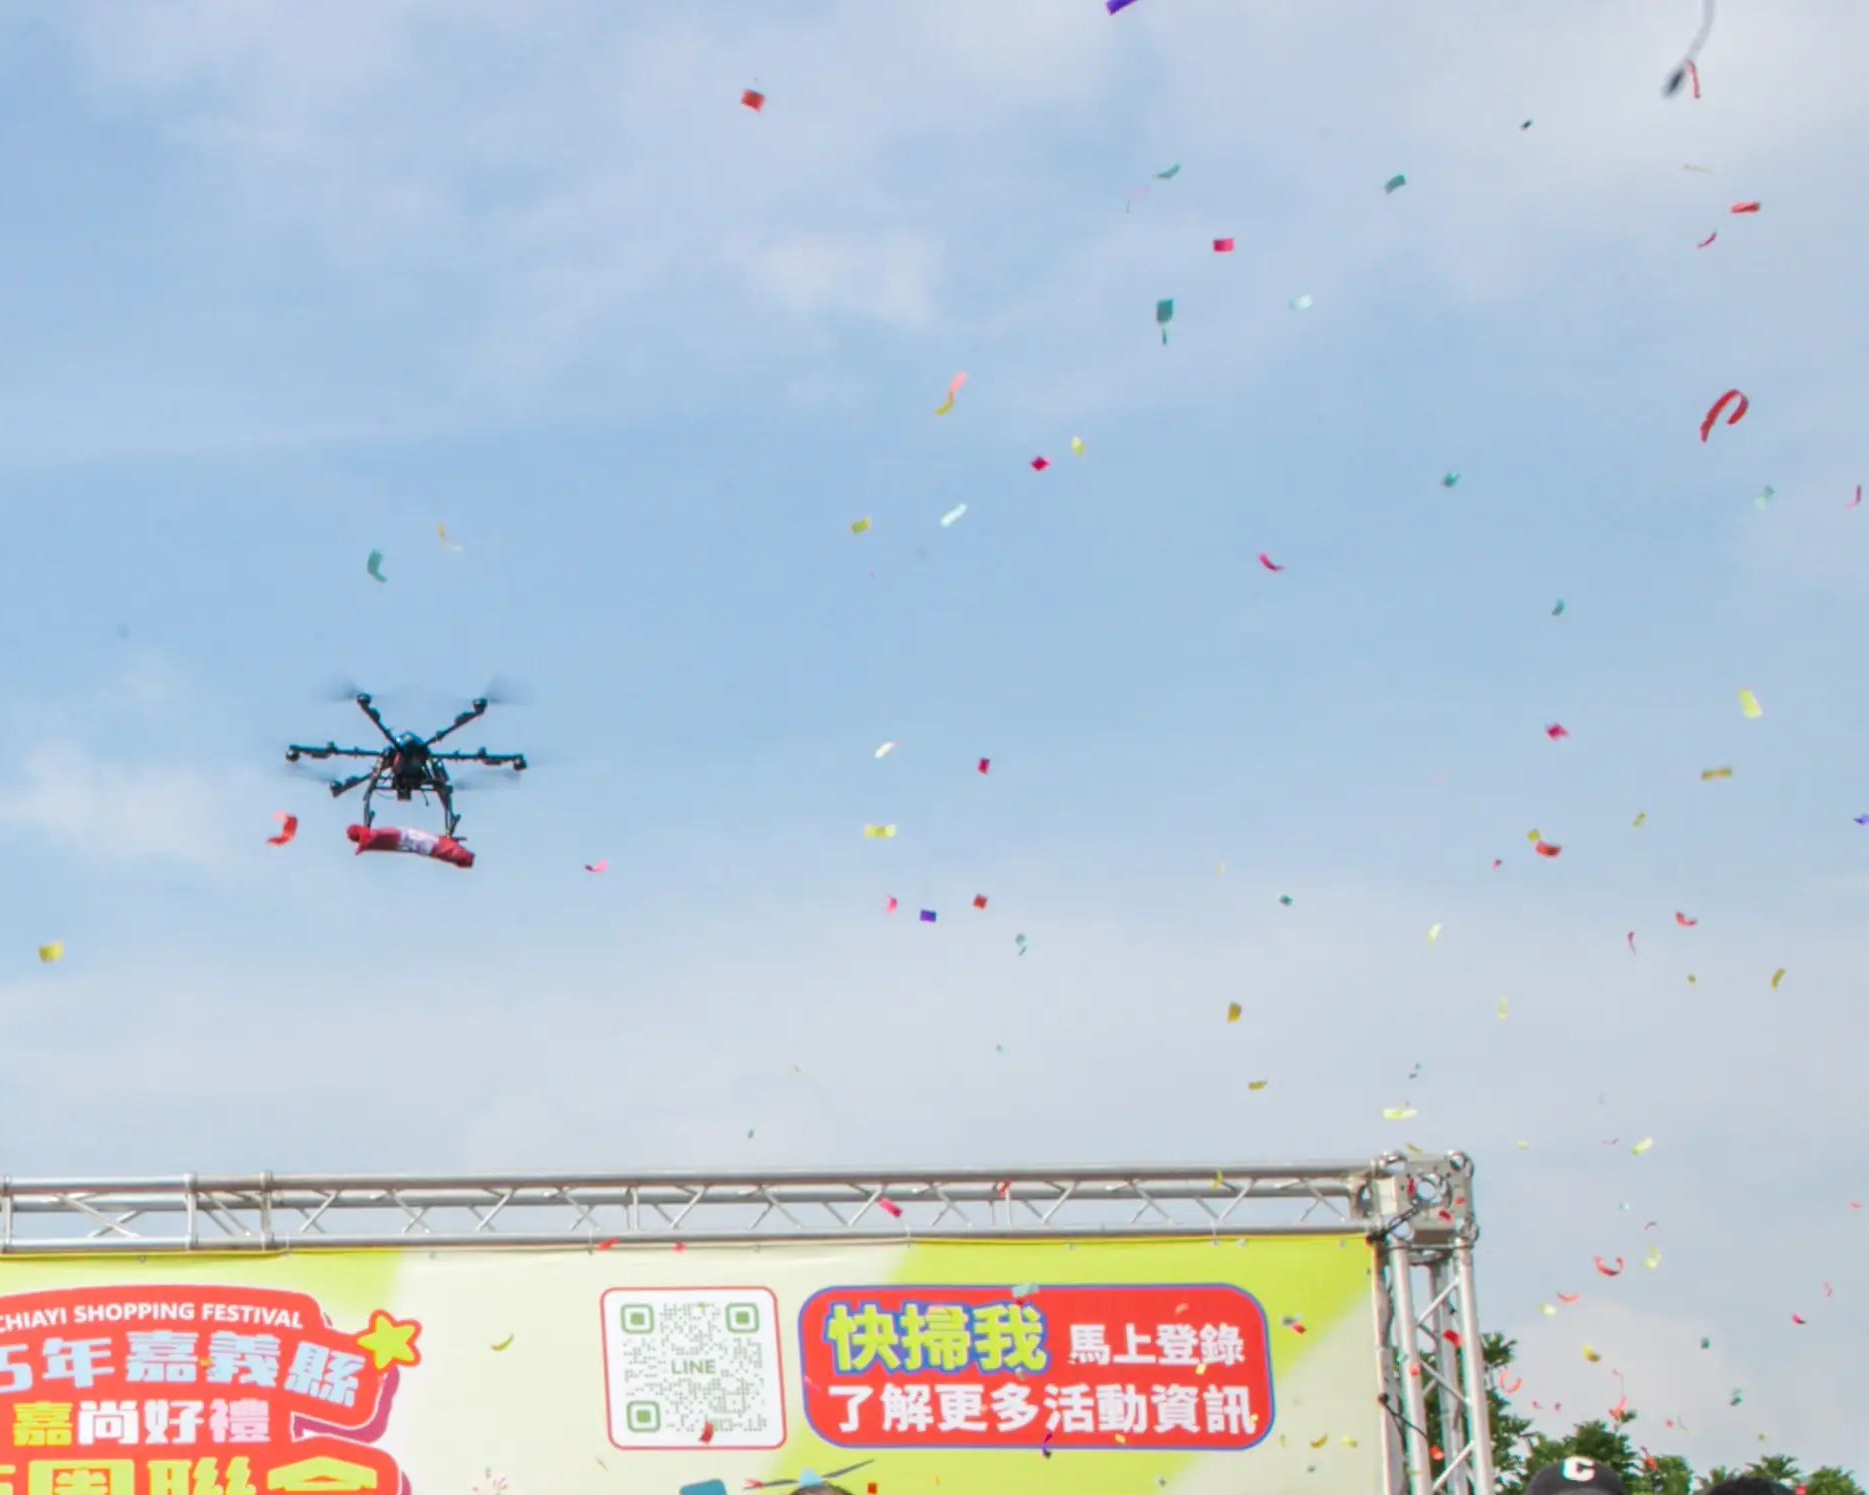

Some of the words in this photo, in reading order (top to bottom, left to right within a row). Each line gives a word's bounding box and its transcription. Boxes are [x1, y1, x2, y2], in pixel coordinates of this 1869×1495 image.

[74, 1302, 195, 1323] SHOPPING
[202, 1303, 303, 1330] FESTIVAL
[827, 1304, 1046, 1372] 快掃我
[1069, 1324, 1245, 1366] 馬上登錄
[671, 1359, 716, 1375] LINE
[13, 1399, 270, 1447] 嘉尚好禮
[829, 1383, 1258, 1435] 了解更多活動資訊
[1565, 1456, 1595, 1481] C
